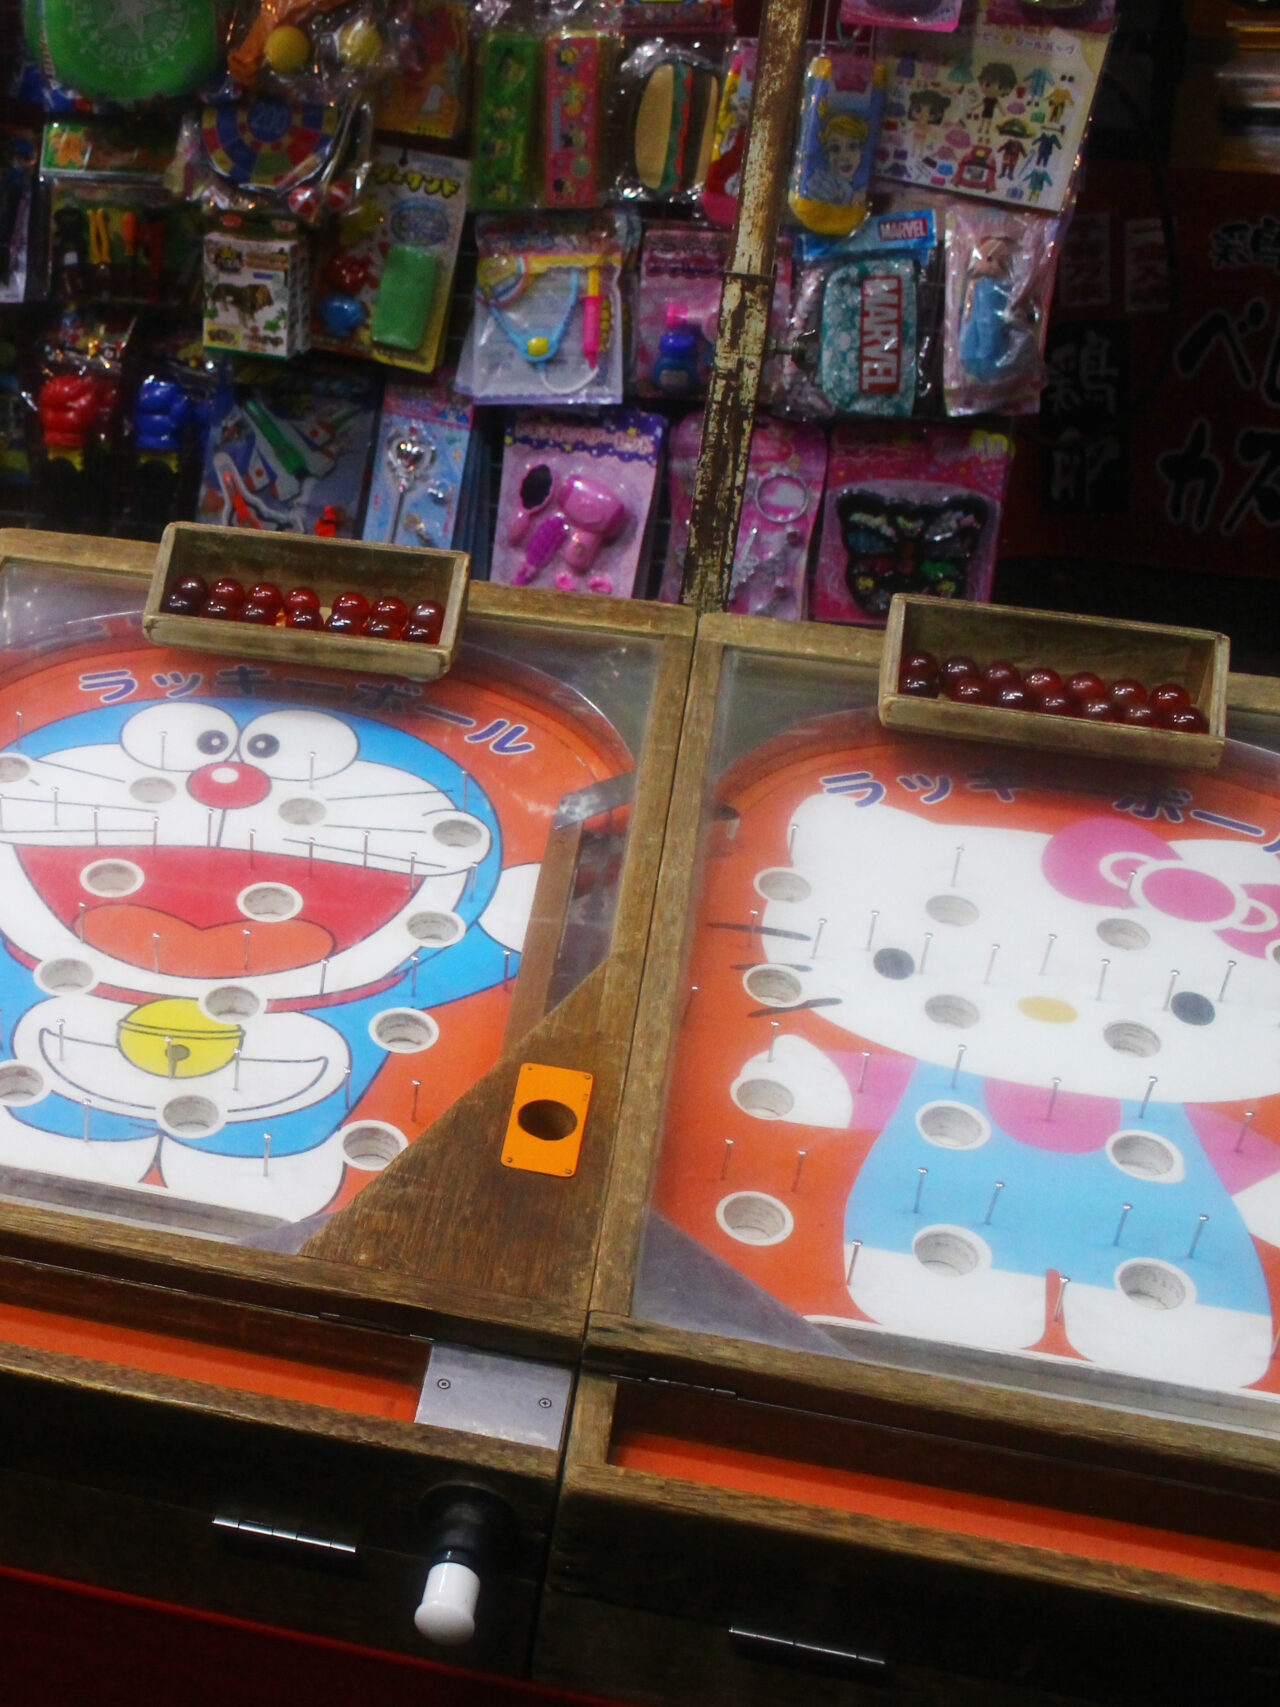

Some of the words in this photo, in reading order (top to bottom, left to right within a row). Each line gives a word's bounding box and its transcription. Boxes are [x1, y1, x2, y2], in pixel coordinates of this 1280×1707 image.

[879, 218, 928, 241] MARVEL
[862, 276, 900, 390] MARVEL
[1173, 296, 1280, 406] ベ
[78, 663, 536, 757] ラッキーボール
[819, 769, 1280, 854] ラッキボー
